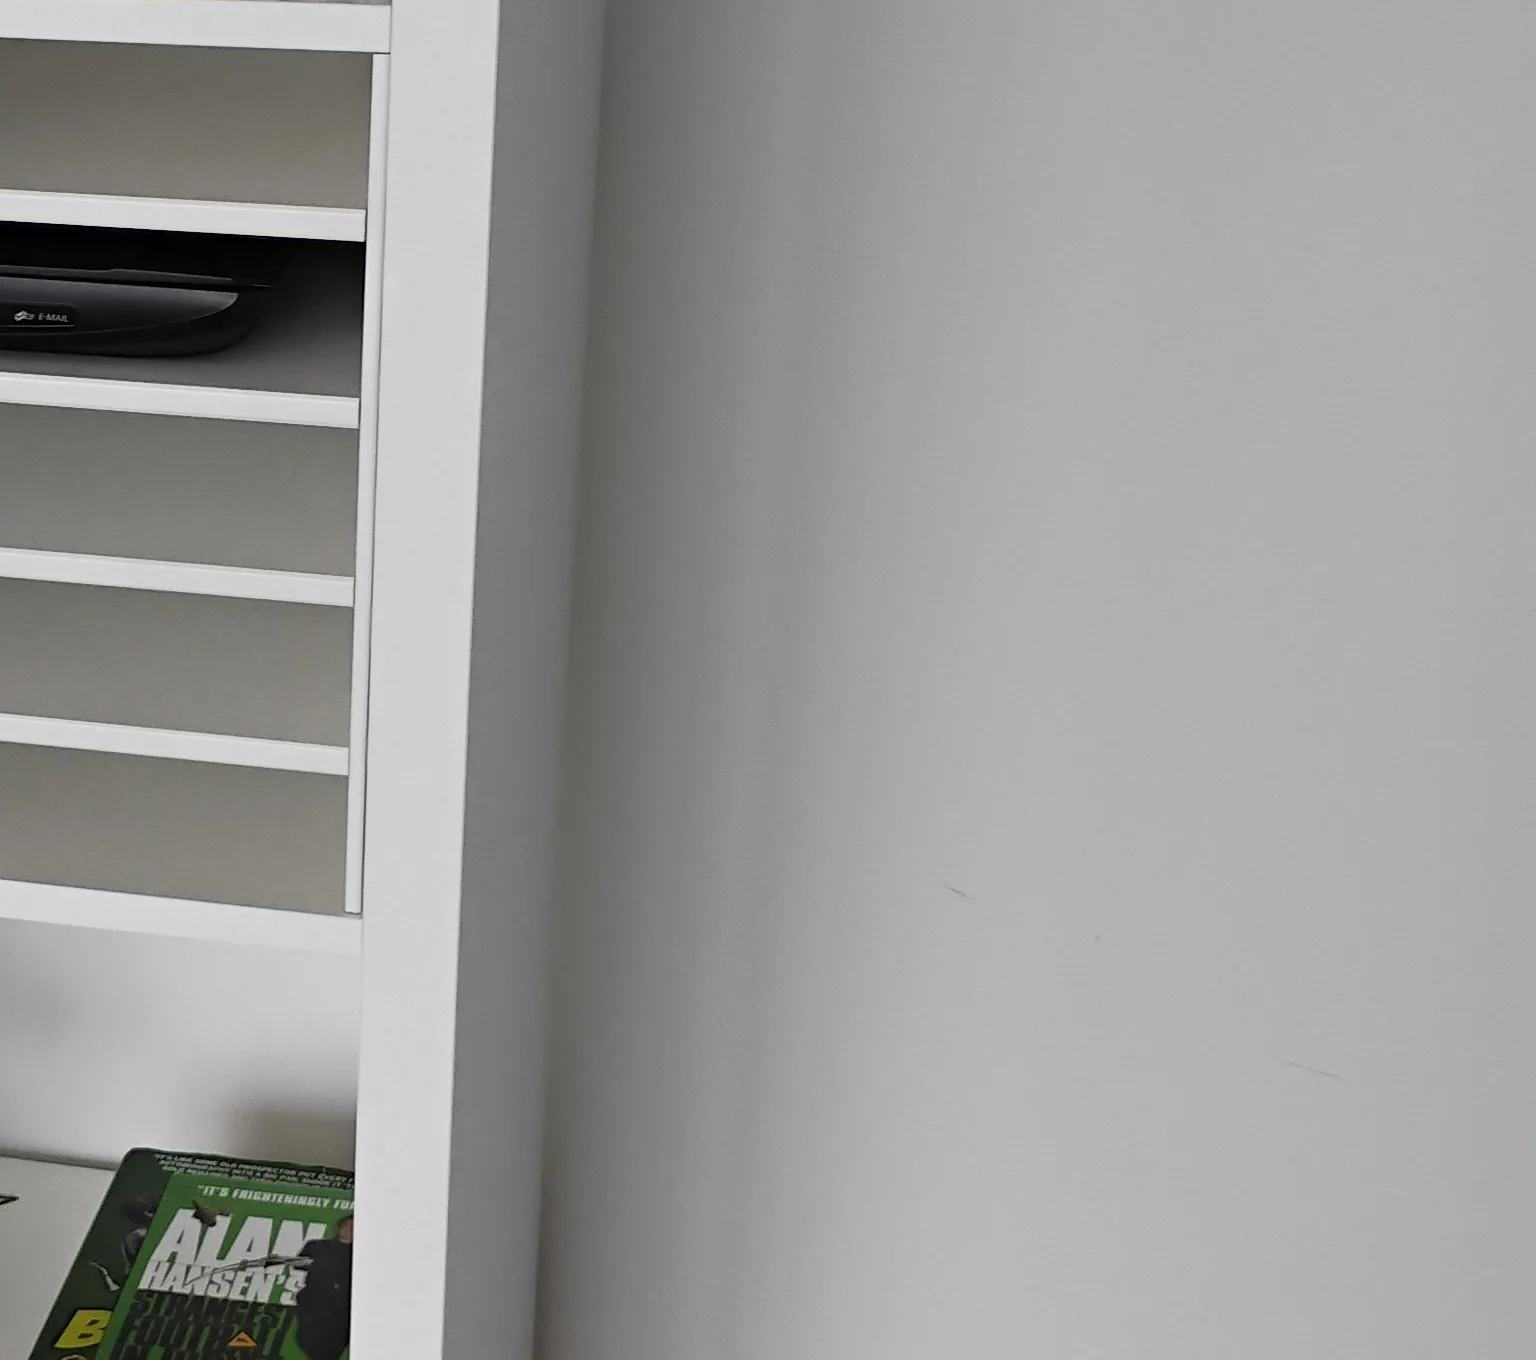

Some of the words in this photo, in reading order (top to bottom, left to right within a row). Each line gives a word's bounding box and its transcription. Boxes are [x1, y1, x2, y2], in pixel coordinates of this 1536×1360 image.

[38, 313, 69, 323] E-MAIL
[232, 1188, 331, 1209] FRIGHTENINGLY
[150, 1208, 327, 1268] ALAN
[138, 1260, 308, 1306] HANSEN'S
